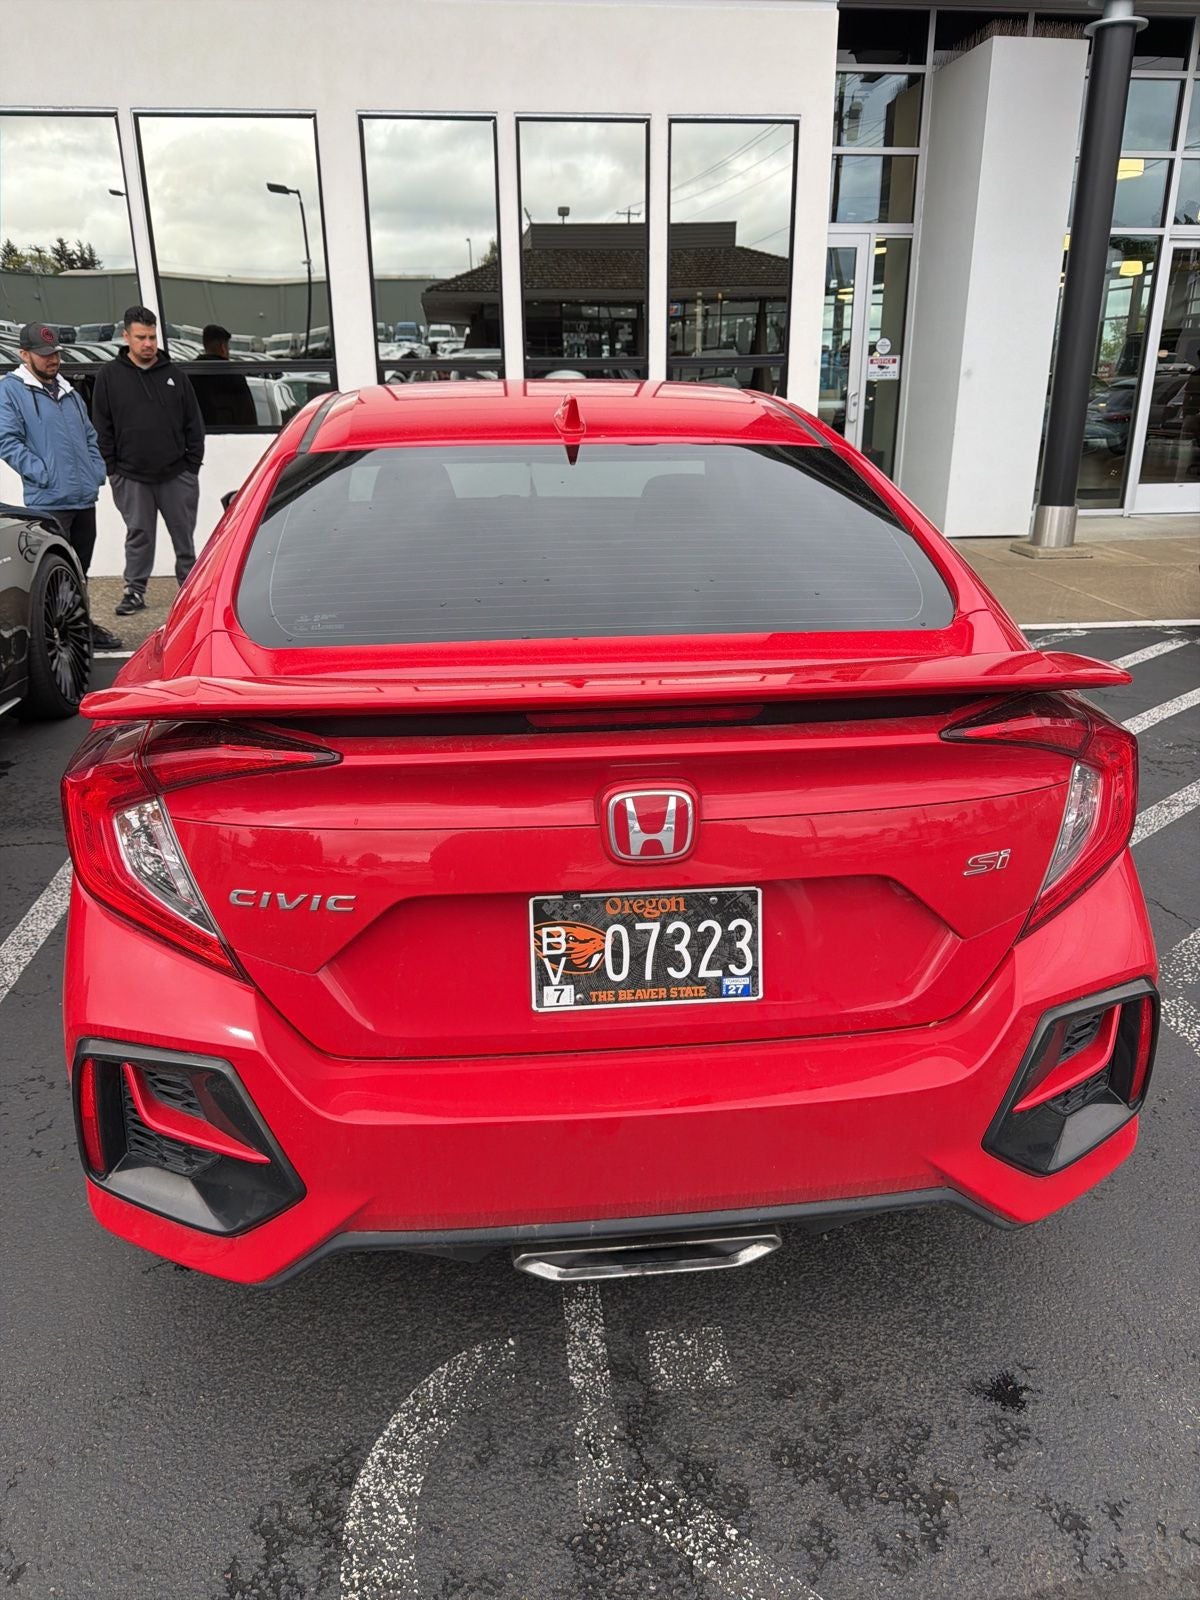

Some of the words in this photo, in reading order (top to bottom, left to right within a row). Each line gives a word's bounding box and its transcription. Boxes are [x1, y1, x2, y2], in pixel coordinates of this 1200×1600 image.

[626, 796, 676, 856] H
[963, 848, 1011, 876] Si
[229, 889, 356, 912] CIVIC
[605, 896, 687, 918] Oregon
[605, 919, 753, 982] 07323
[553, 988, 565, 1004] 7
[590, 990, 616, 1003] THE
[618, 987, 668, 1001] BEAVER
[669, 985, 707, 998] STATE
[728, 984, 744, 995] 27
